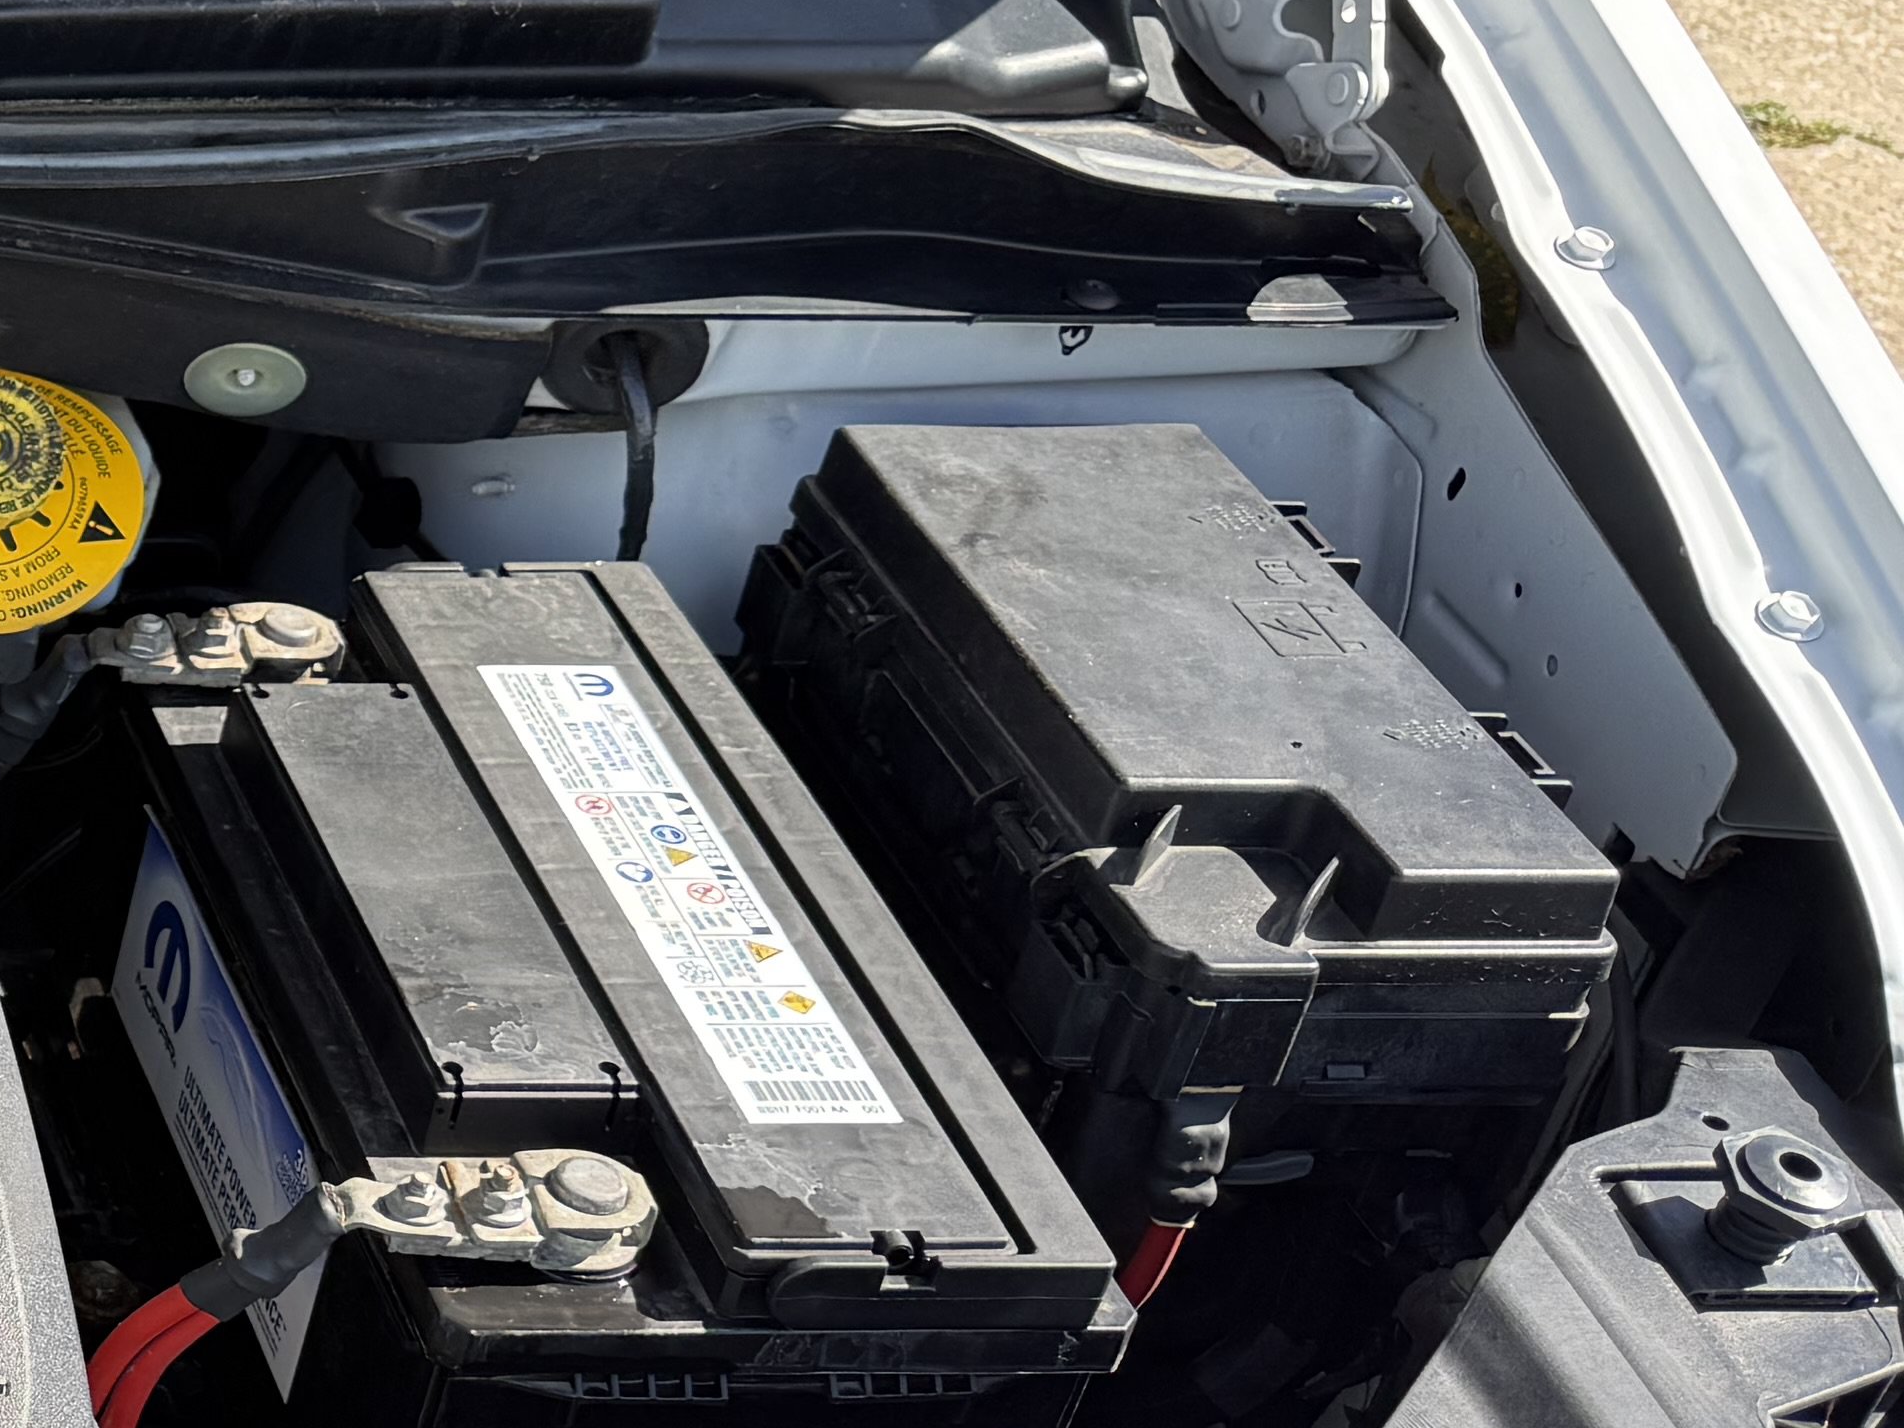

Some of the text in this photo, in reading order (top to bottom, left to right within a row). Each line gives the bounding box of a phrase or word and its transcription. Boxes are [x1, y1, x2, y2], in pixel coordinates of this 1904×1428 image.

[23, 545, 60, 574] FROM
[178, 1089, 219, 1189] ULTIMATE
[183, 1064, 227, 1163] ULTIMATE
[223, 1157, 257, 1230] POWER
